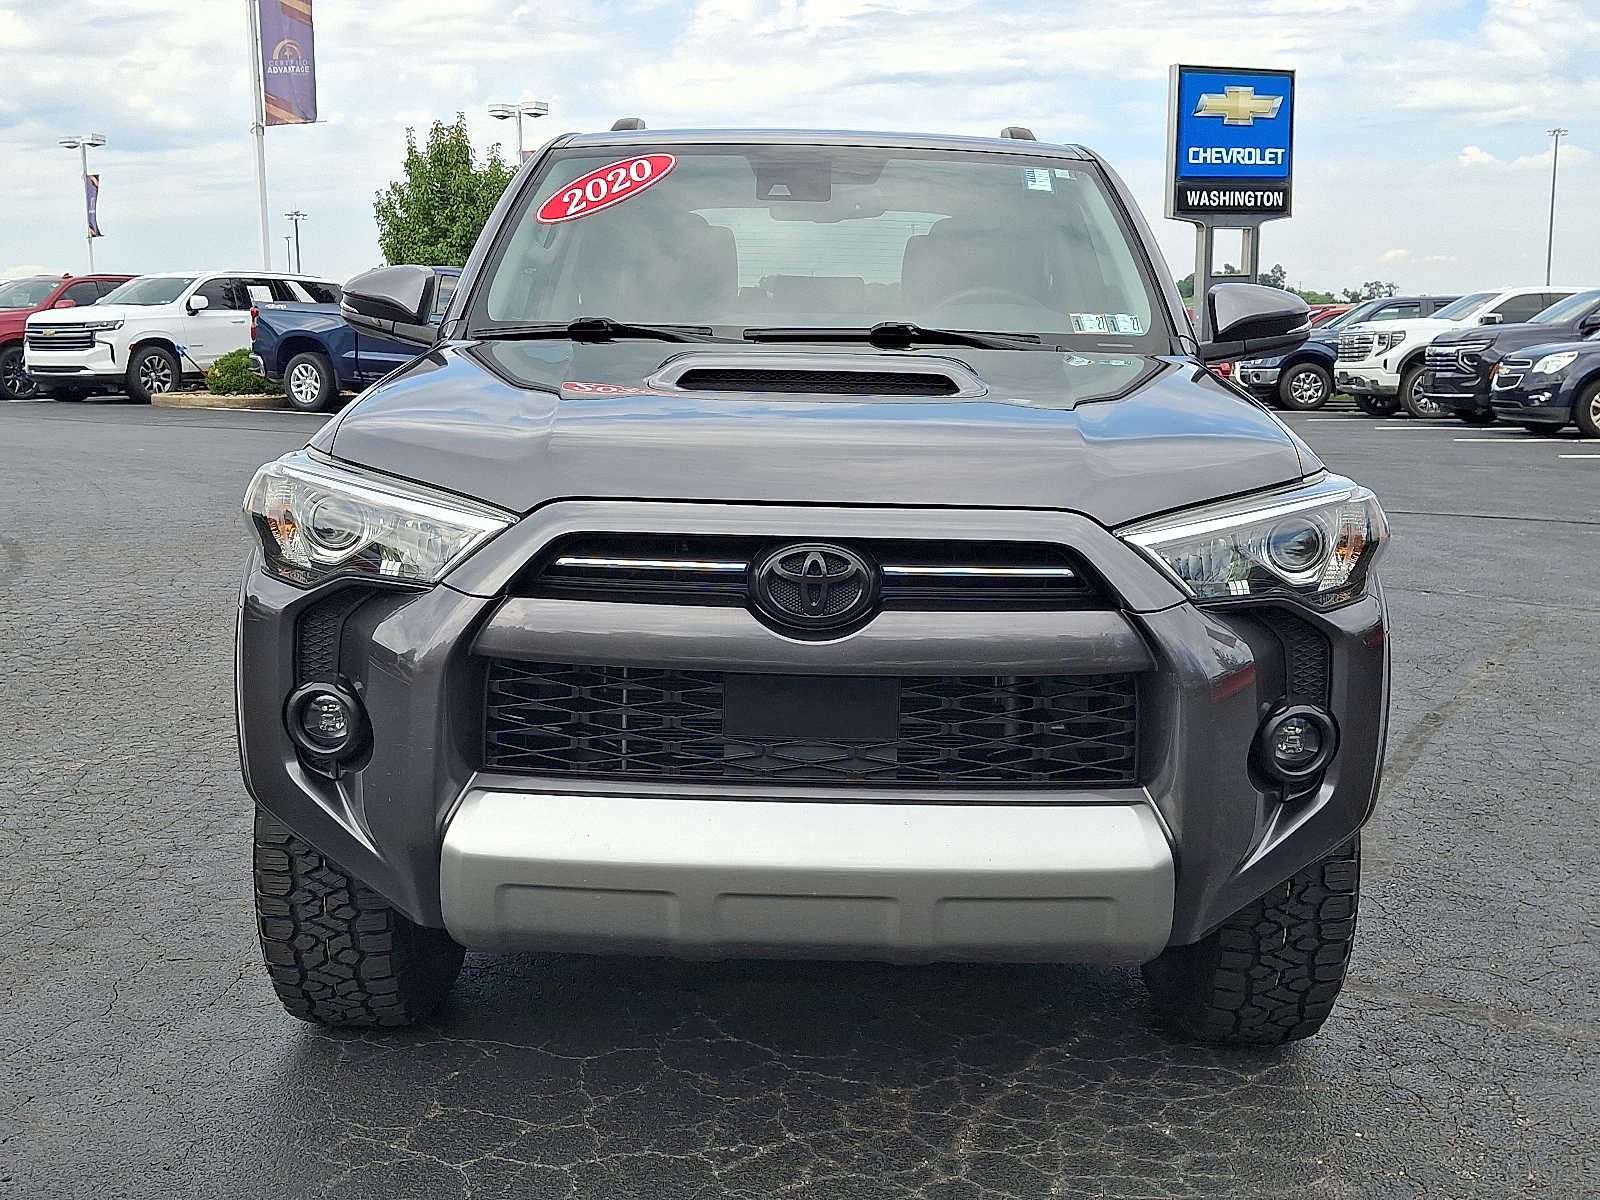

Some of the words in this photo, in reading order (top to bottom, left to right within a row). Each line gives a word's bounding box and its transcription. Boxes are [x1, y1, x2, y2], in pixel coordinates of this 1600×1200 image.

[267, 65, 310, 73] ADVANTAGE
[1188, 147, 1285, 165] CHEVROLET
[562, 159, 652, 215] 2020
[1186, 190, 1283, 207] WASHINGTON
